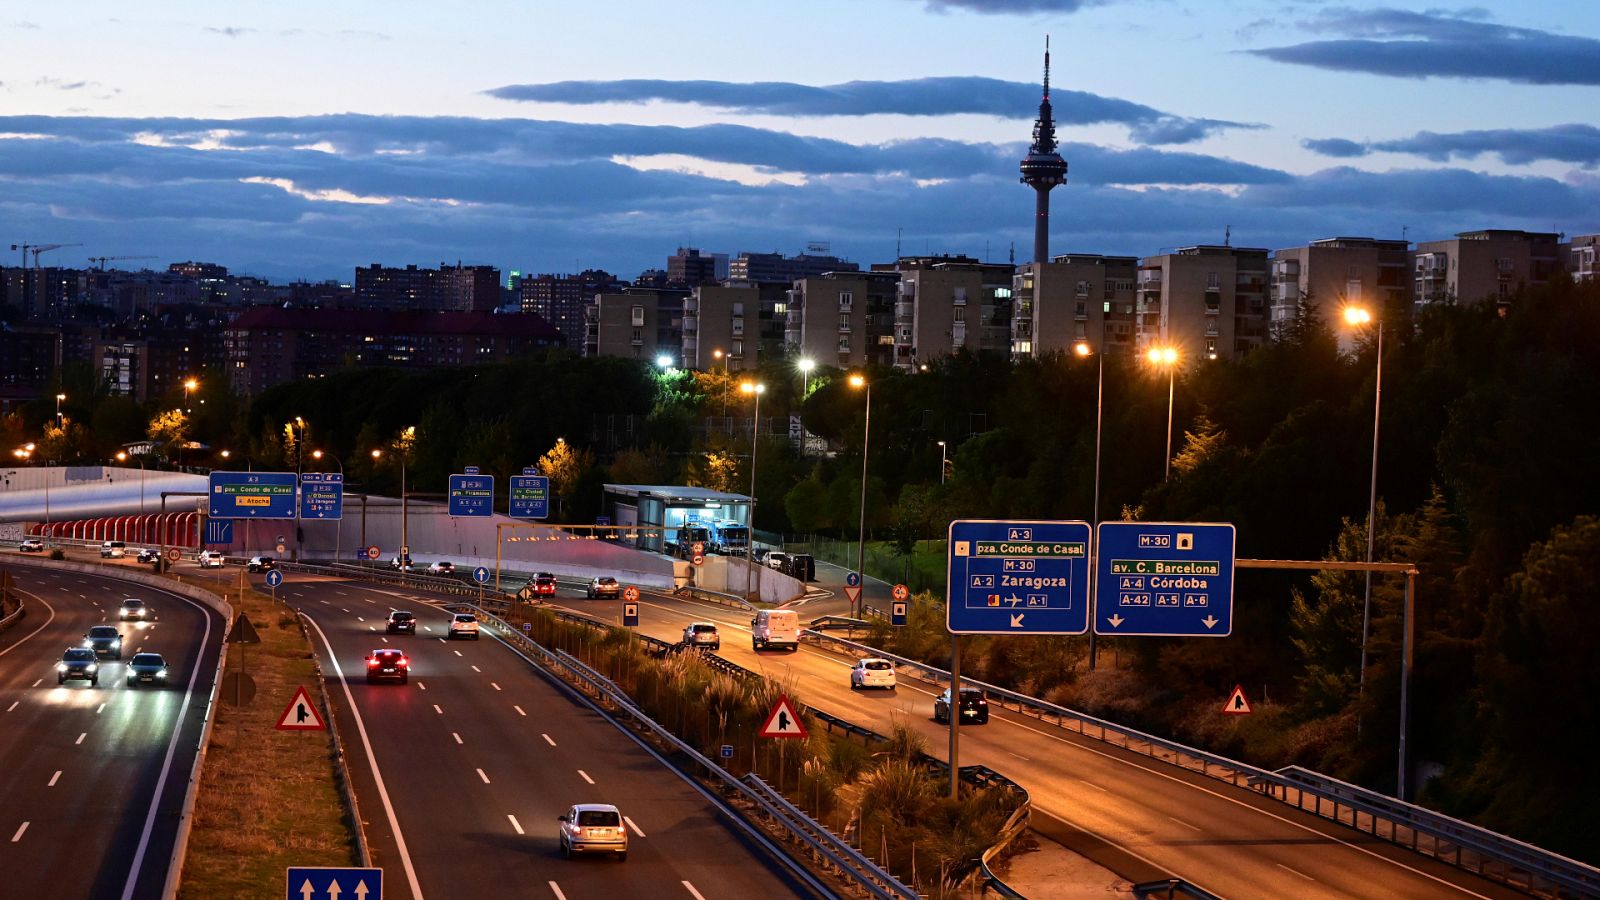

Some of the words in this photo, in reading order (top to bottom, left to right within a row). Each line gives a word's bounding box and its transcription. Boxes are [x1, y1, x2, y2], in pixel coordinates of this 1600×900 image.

[1010, 530, 1030, 540] A-3
[1140, 536, 1169, 546] M-30
[977, 545, 998, 555] pza.
[1000, 543, 1033, 553] Conde
[1036, 544, 1050, 553] de
[1053, 545, 1084, 555] Casal
[1005, 561, 1034, 570] M-30
[1113, 563, 1131, 573] av.
[1136, 562, 1150, 573] C.
[1155, 562, 1217, 574] Barcelona
[972, 577, 993, 586] A-2
[1001, 575, 1067, 590] Zaragoza
[1122, 578, 1143, 588] A-4
[1150, 577, 1208, 589] Córdoba
[1029, 596, 1046, 605] A-1
[1121, 594, 1149, 604] A-42
[1157, 595, 1178, 605] A-5
[1186, 595, 1206, 605] A-6
